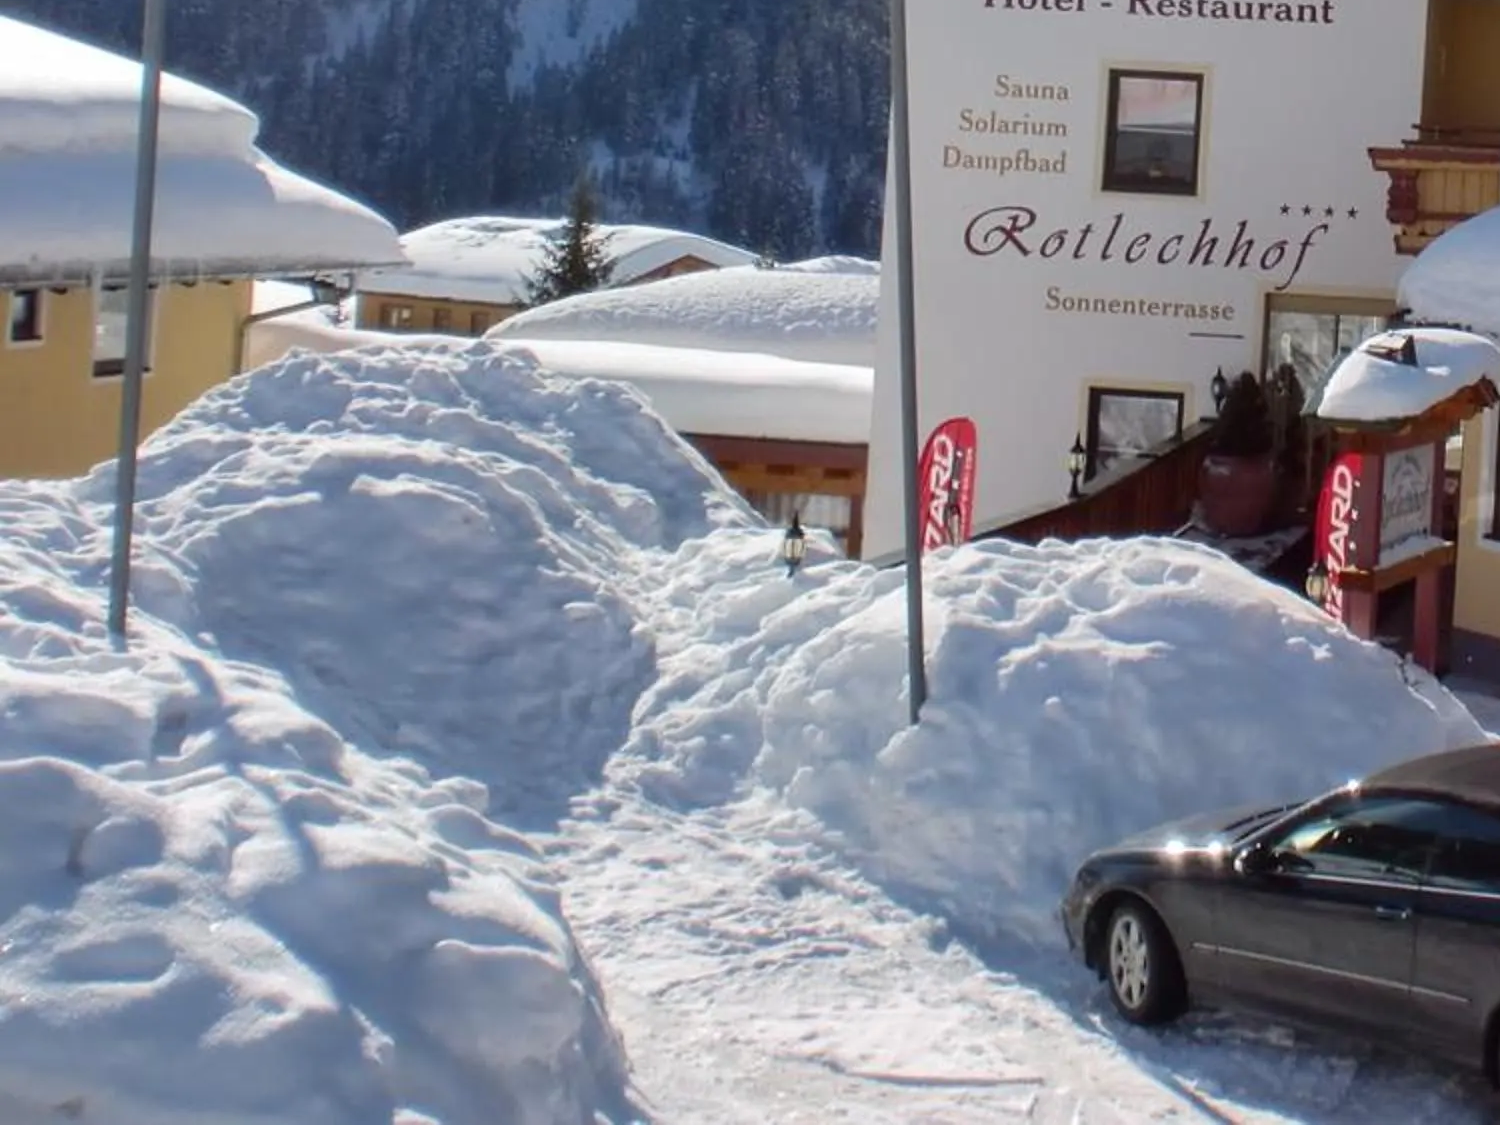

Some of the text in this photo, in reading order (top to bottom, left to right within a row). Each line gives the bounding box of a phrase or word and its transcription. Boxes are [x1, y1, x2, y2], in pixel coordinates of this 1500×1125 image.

[994, 75, 1071, 102] Sauna
[958, 109, 1069, 139] Solarium
[943, 145, 1067, 176] Dampfbad
[964, 206, 1330, 291] Rotlechhof
[1046, 286, 1236, 322] Sonnenterrasse
